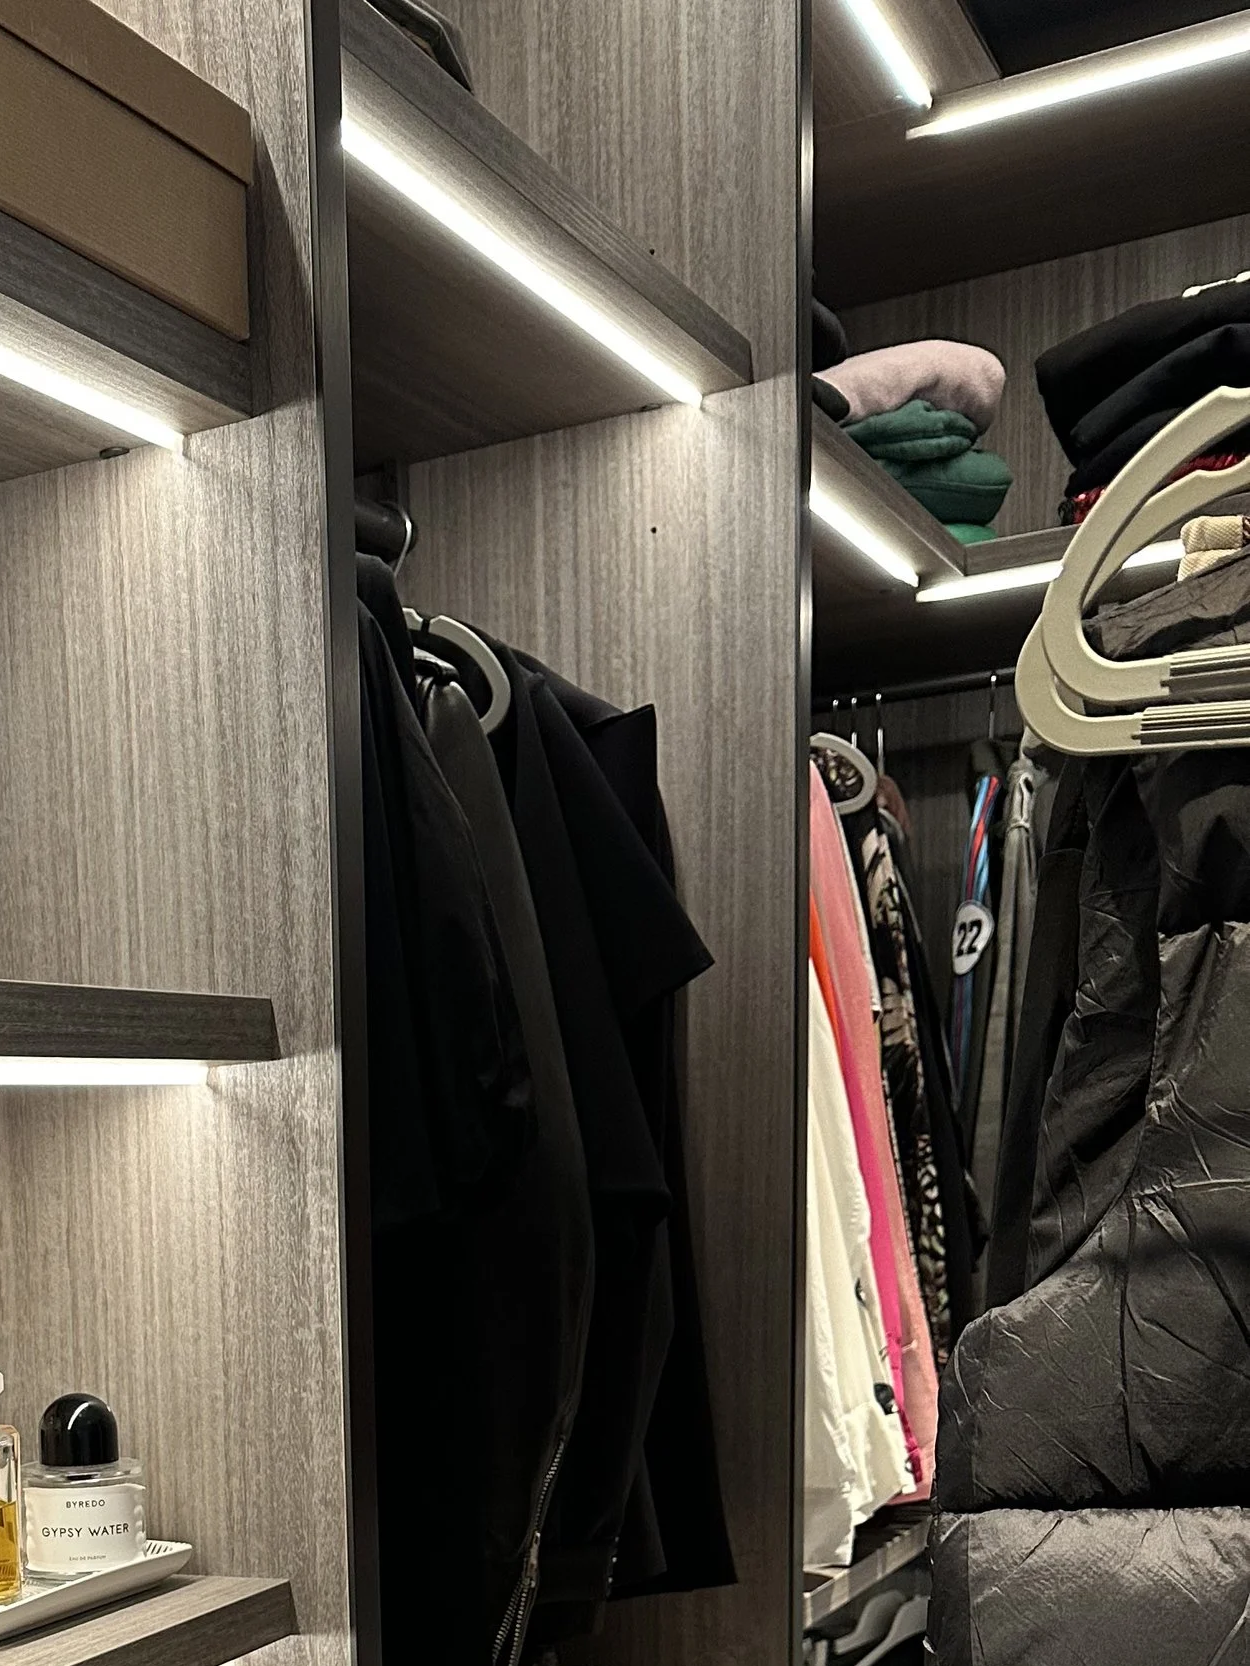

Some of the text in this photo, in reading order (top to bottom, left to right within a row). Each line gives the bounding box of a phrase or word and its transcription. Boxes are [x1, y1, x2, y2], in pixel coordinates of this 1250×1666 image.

[956, 918, 983, 957] 22
[65, 1499, 106, 1509] BYREDO
[41, 1522, 130, 1538] GYPSY WATER
